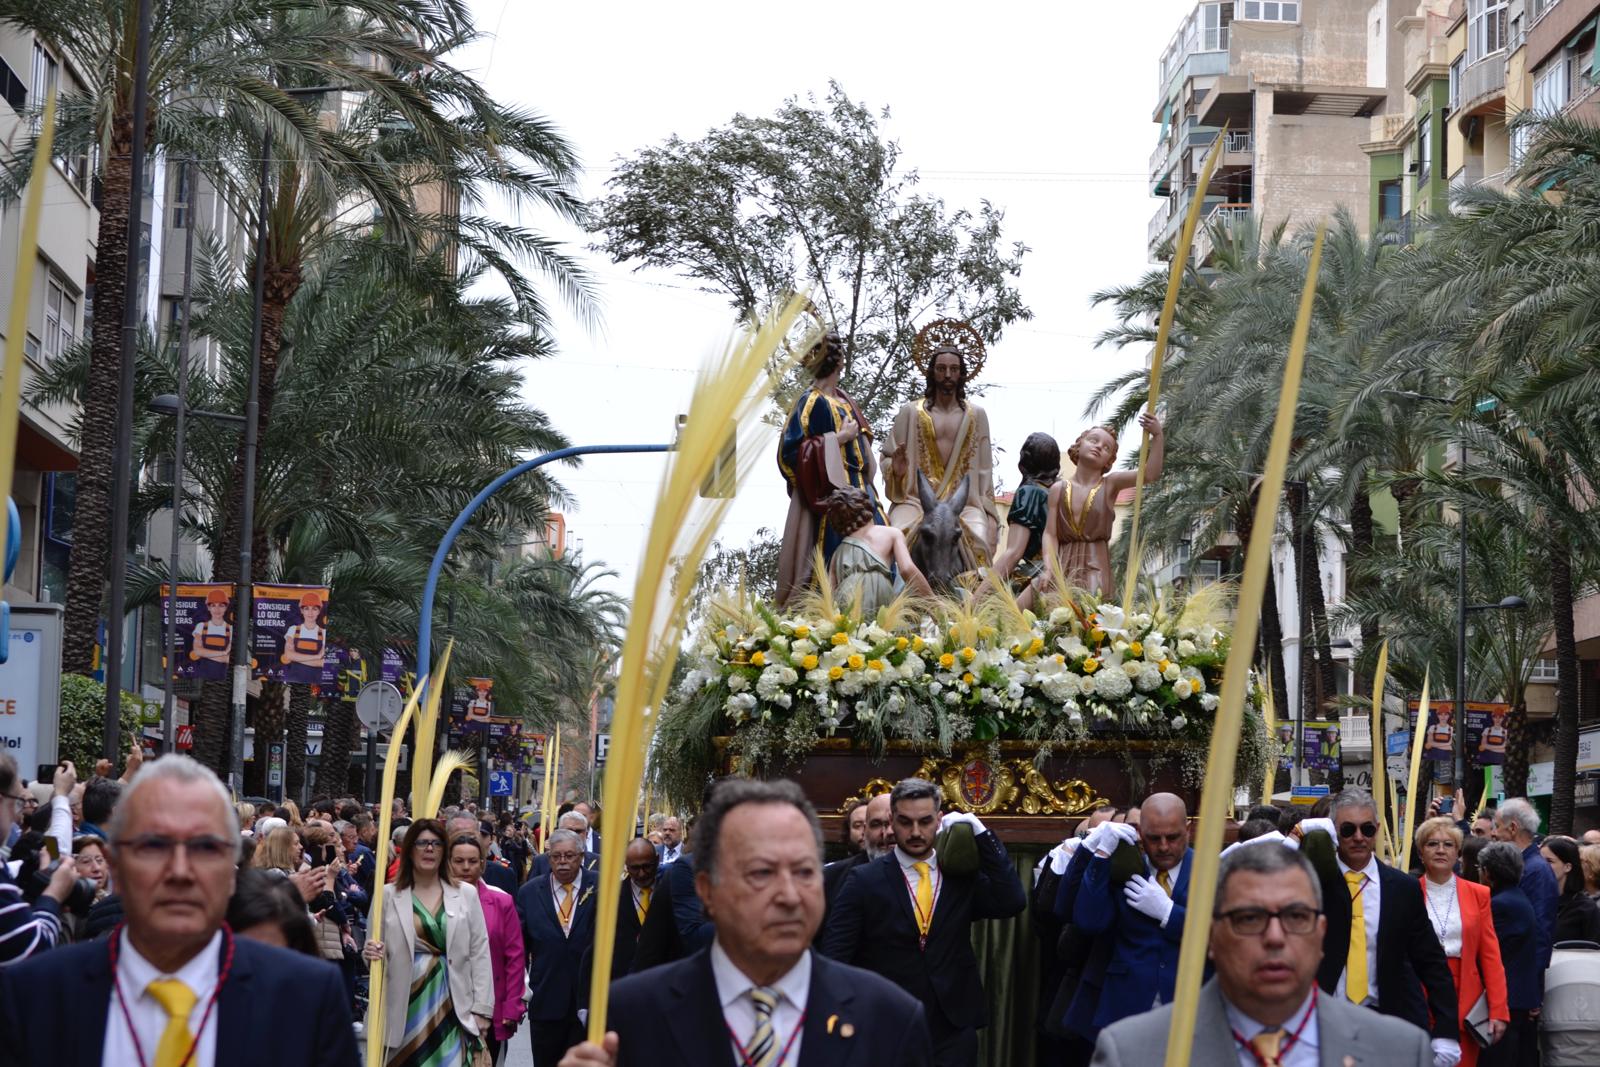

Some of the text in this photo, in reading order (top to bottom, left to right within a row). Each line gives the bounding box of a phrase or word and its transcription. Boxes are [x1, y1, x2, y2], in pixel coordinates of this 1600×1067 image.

[257, 602, 291, 611] CONSIGUE
[257, 611, 281, 619] LO QUE
[164, 617, 193, 625] QERAS
[256, 619, 286, 627] QUIERAS
